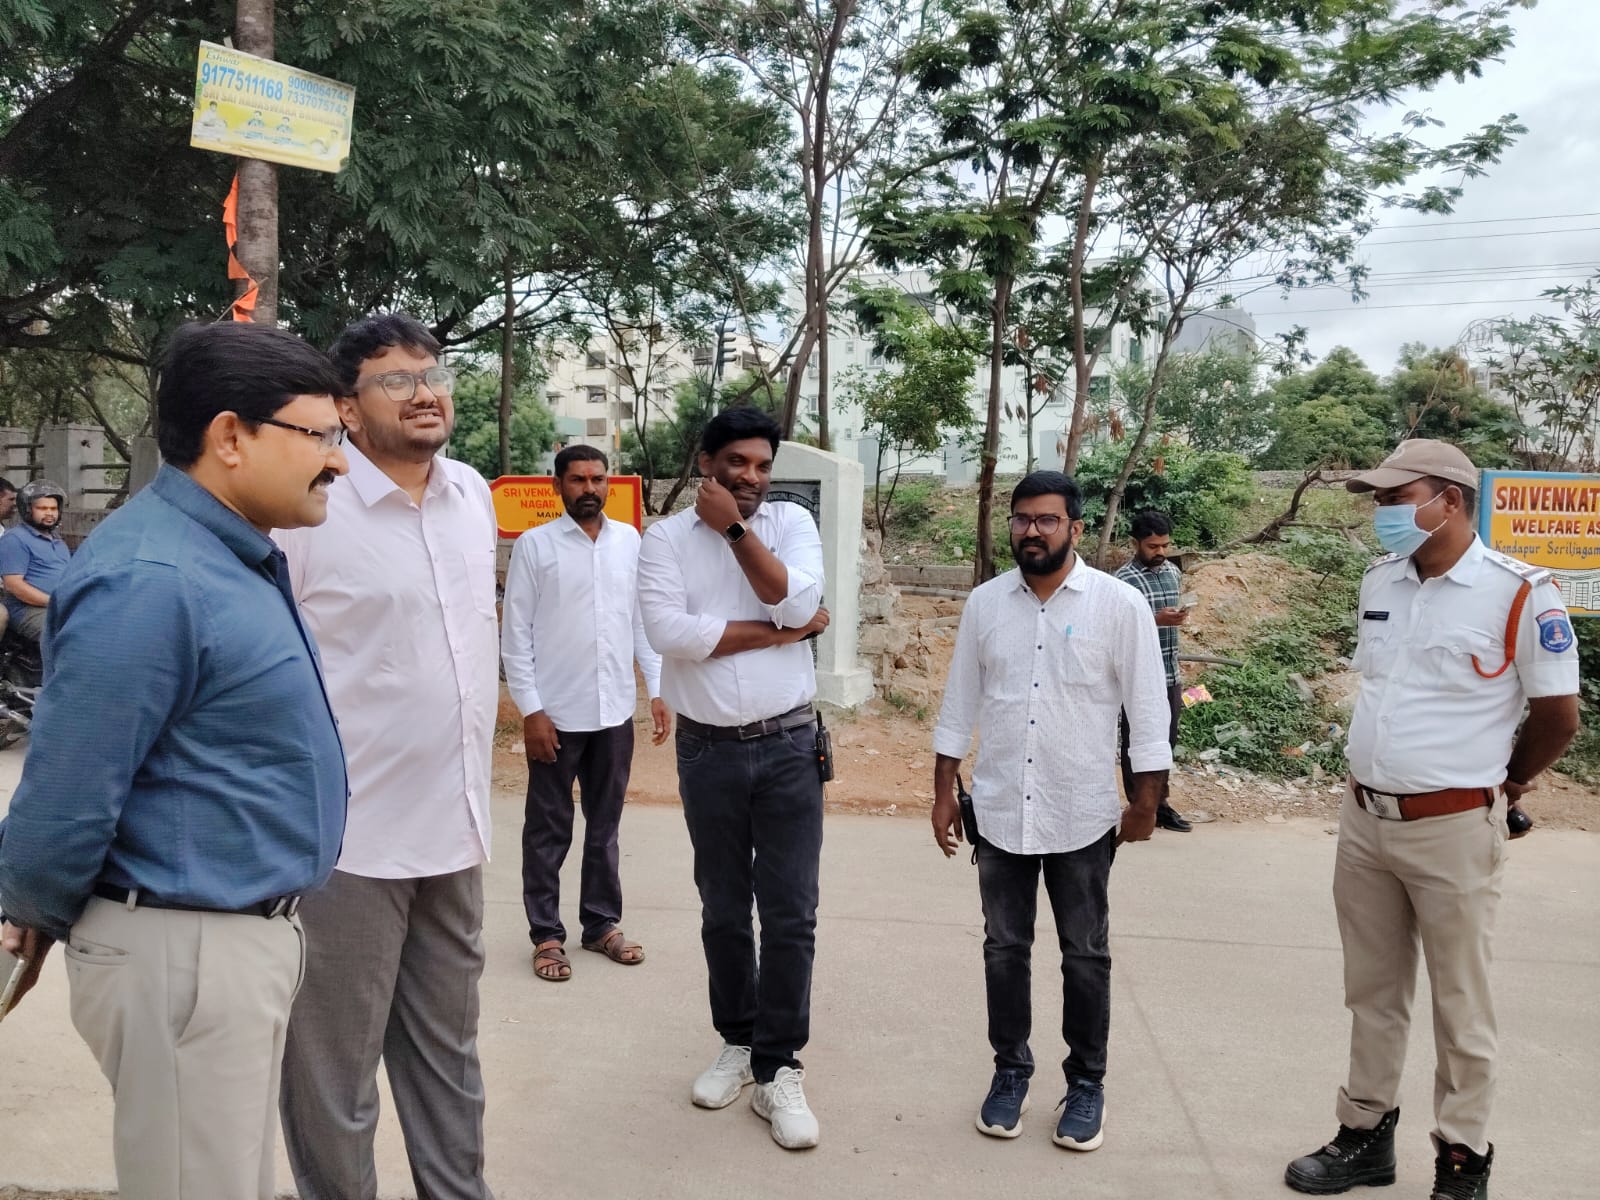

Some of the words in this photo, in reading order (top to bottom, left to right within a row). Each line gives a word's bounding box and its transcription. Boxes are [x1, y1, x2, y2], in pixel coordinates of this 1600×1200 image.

[201, 62, 284, 101] 9177511168
[503, 487, 521, 497] SRI
[520, 499, 556, 509] NAGAR
[1512, 518, 1581, 535] WELFARE
